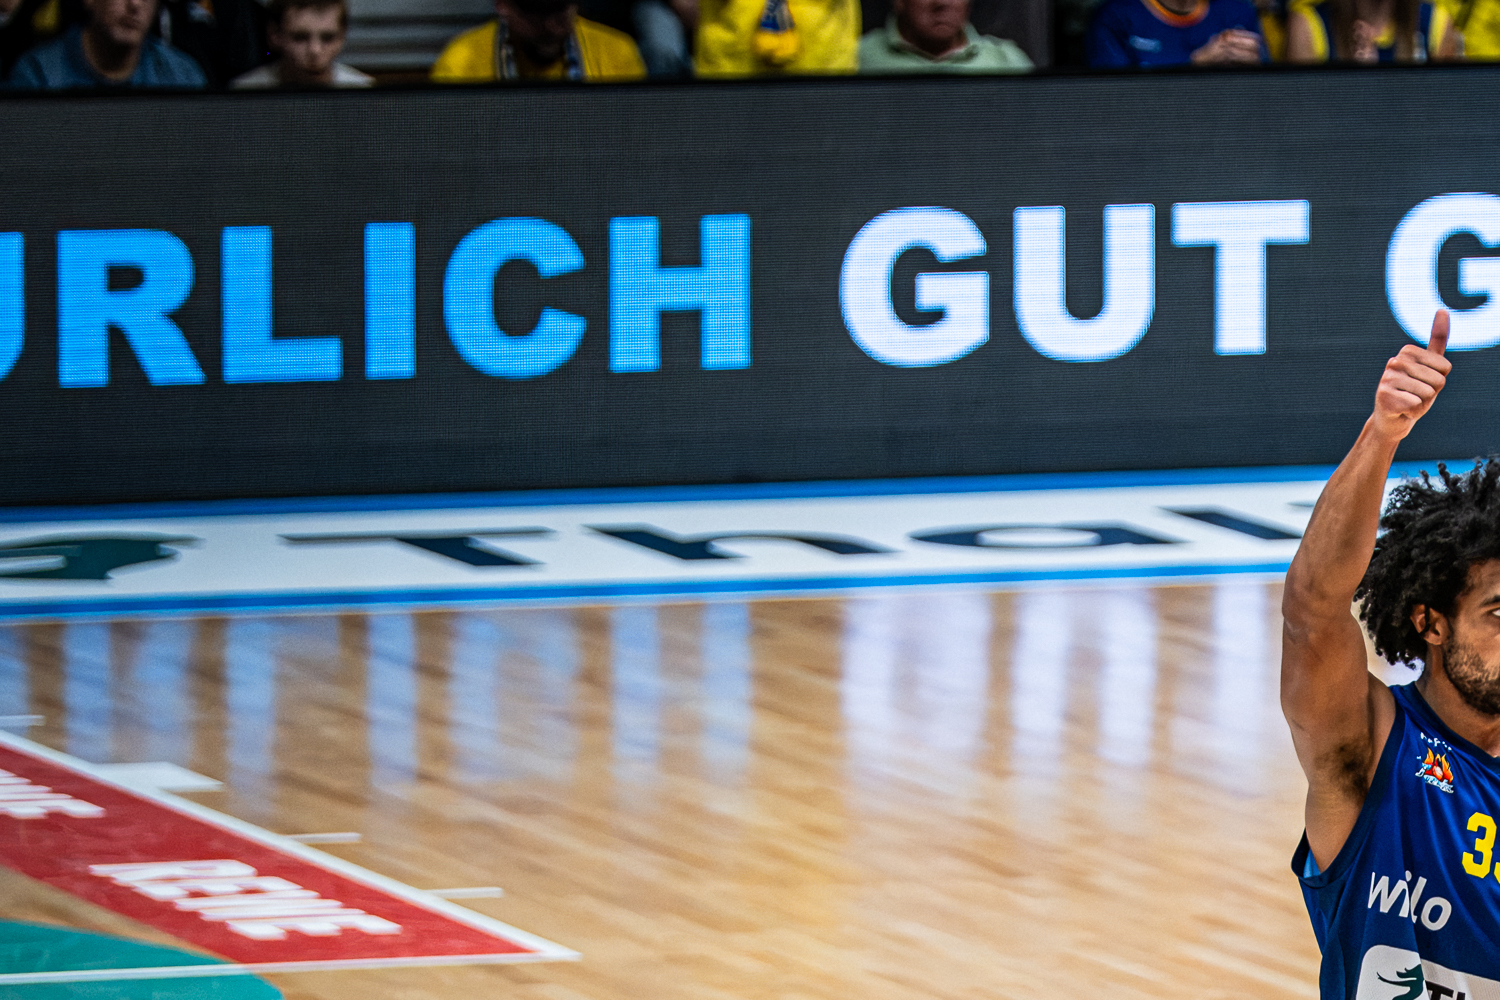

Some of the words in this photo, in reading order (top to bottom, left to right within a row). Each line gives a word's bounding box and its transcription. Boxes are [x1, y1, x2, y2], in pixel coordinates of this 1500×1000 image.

[0, 213, 752, 388] RLICH
[838, 199, 1311, 368] GUT
[1367, 869, 1452, 931] wilo
